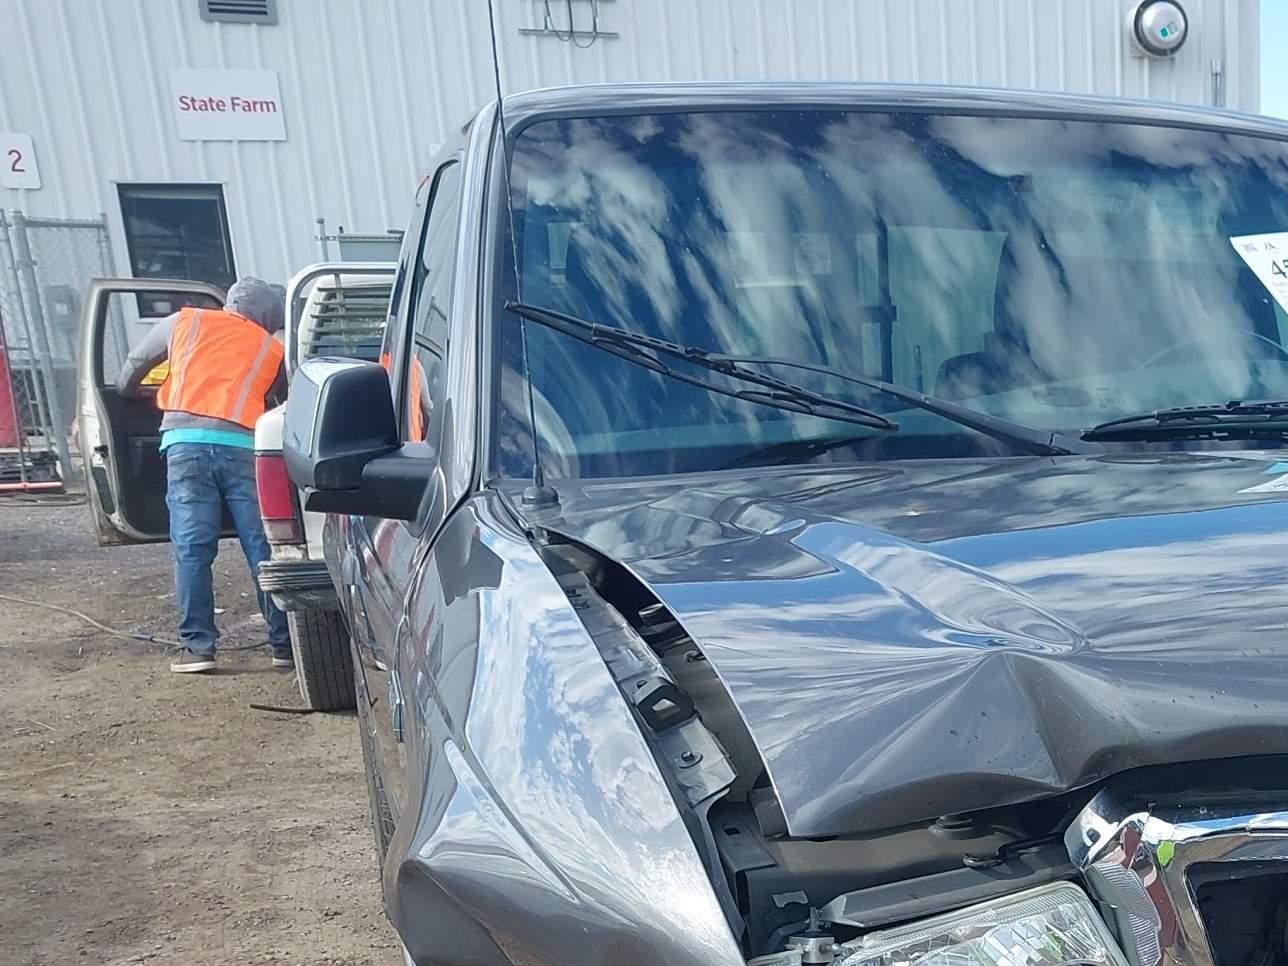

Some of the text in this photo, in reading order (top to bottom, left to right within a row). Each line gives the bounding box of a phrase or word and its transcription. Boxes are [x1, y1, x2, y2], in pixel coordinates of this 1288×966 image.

[178, 95, 277, 113] State Farm
[8, 149, 26, 173] 2
